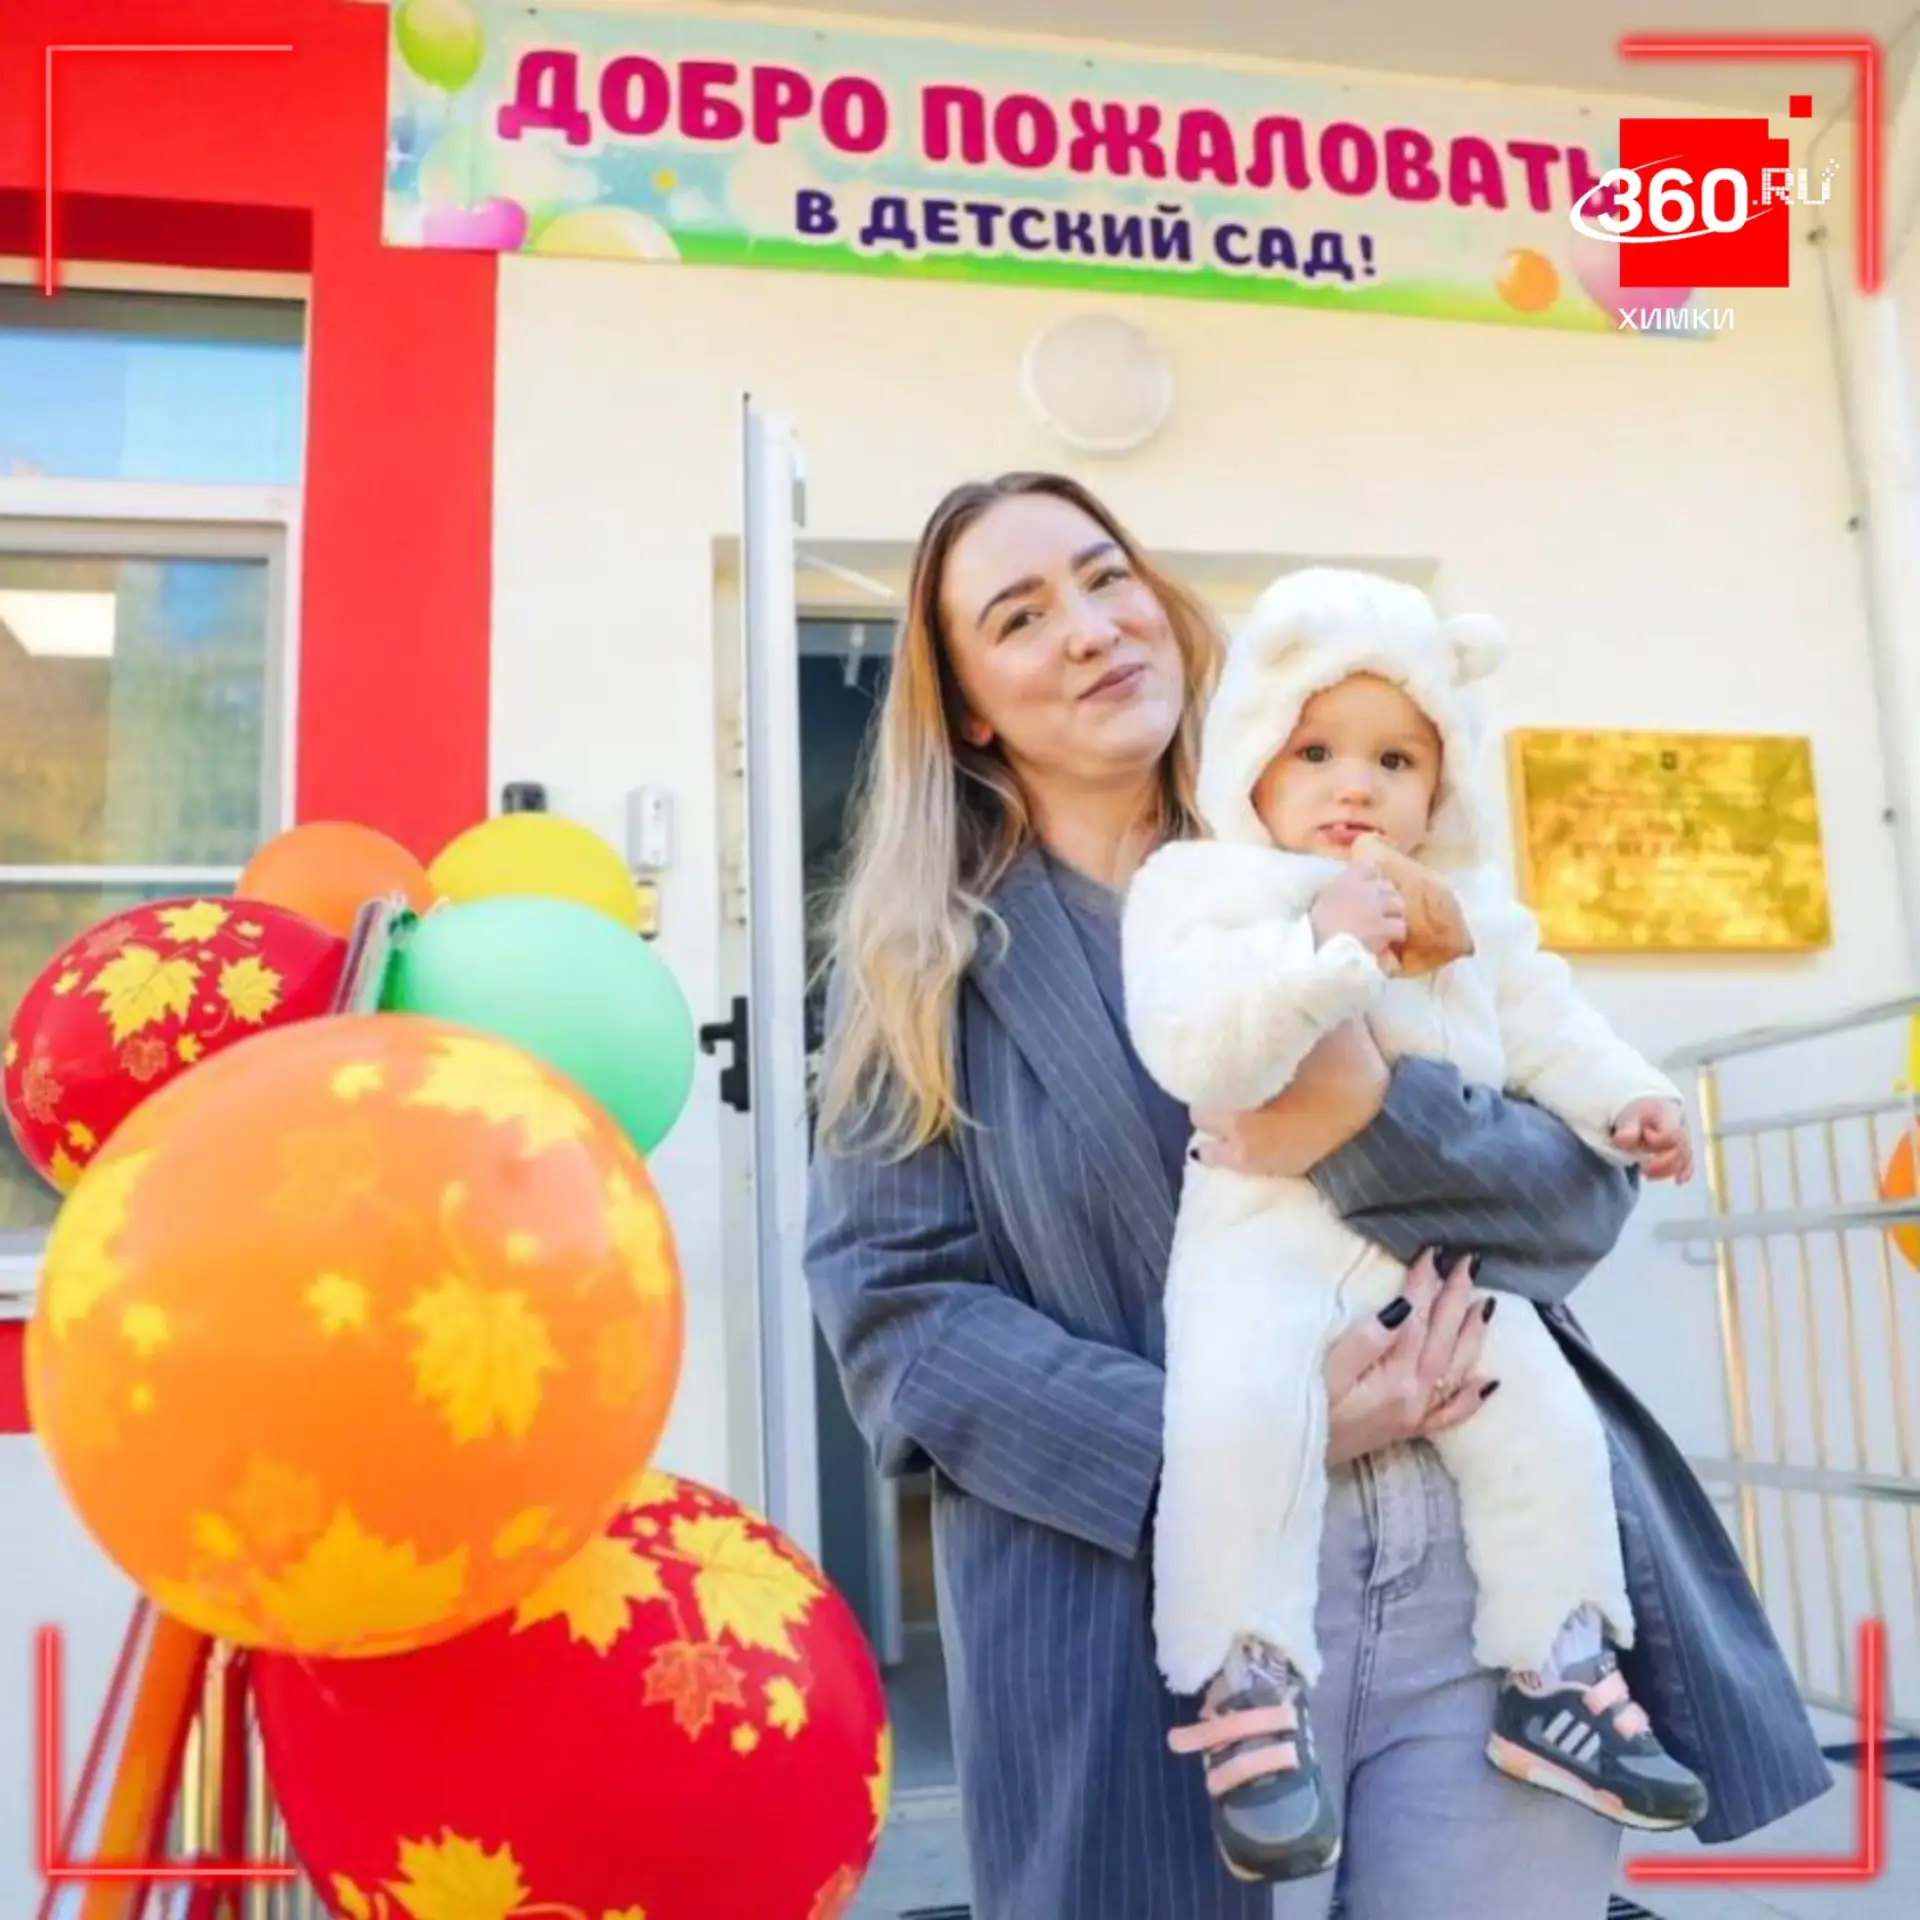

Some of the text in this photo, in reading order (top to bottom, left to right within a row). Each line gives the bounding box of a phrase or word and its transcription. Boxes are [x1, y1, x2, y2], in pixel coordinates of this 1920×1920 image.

[497, 49, 1620, 218] ДОБРО ПОЖАЛОВАТЬ
[794, 190, 1378, 281] В ДЕТСКИЙ САД!
